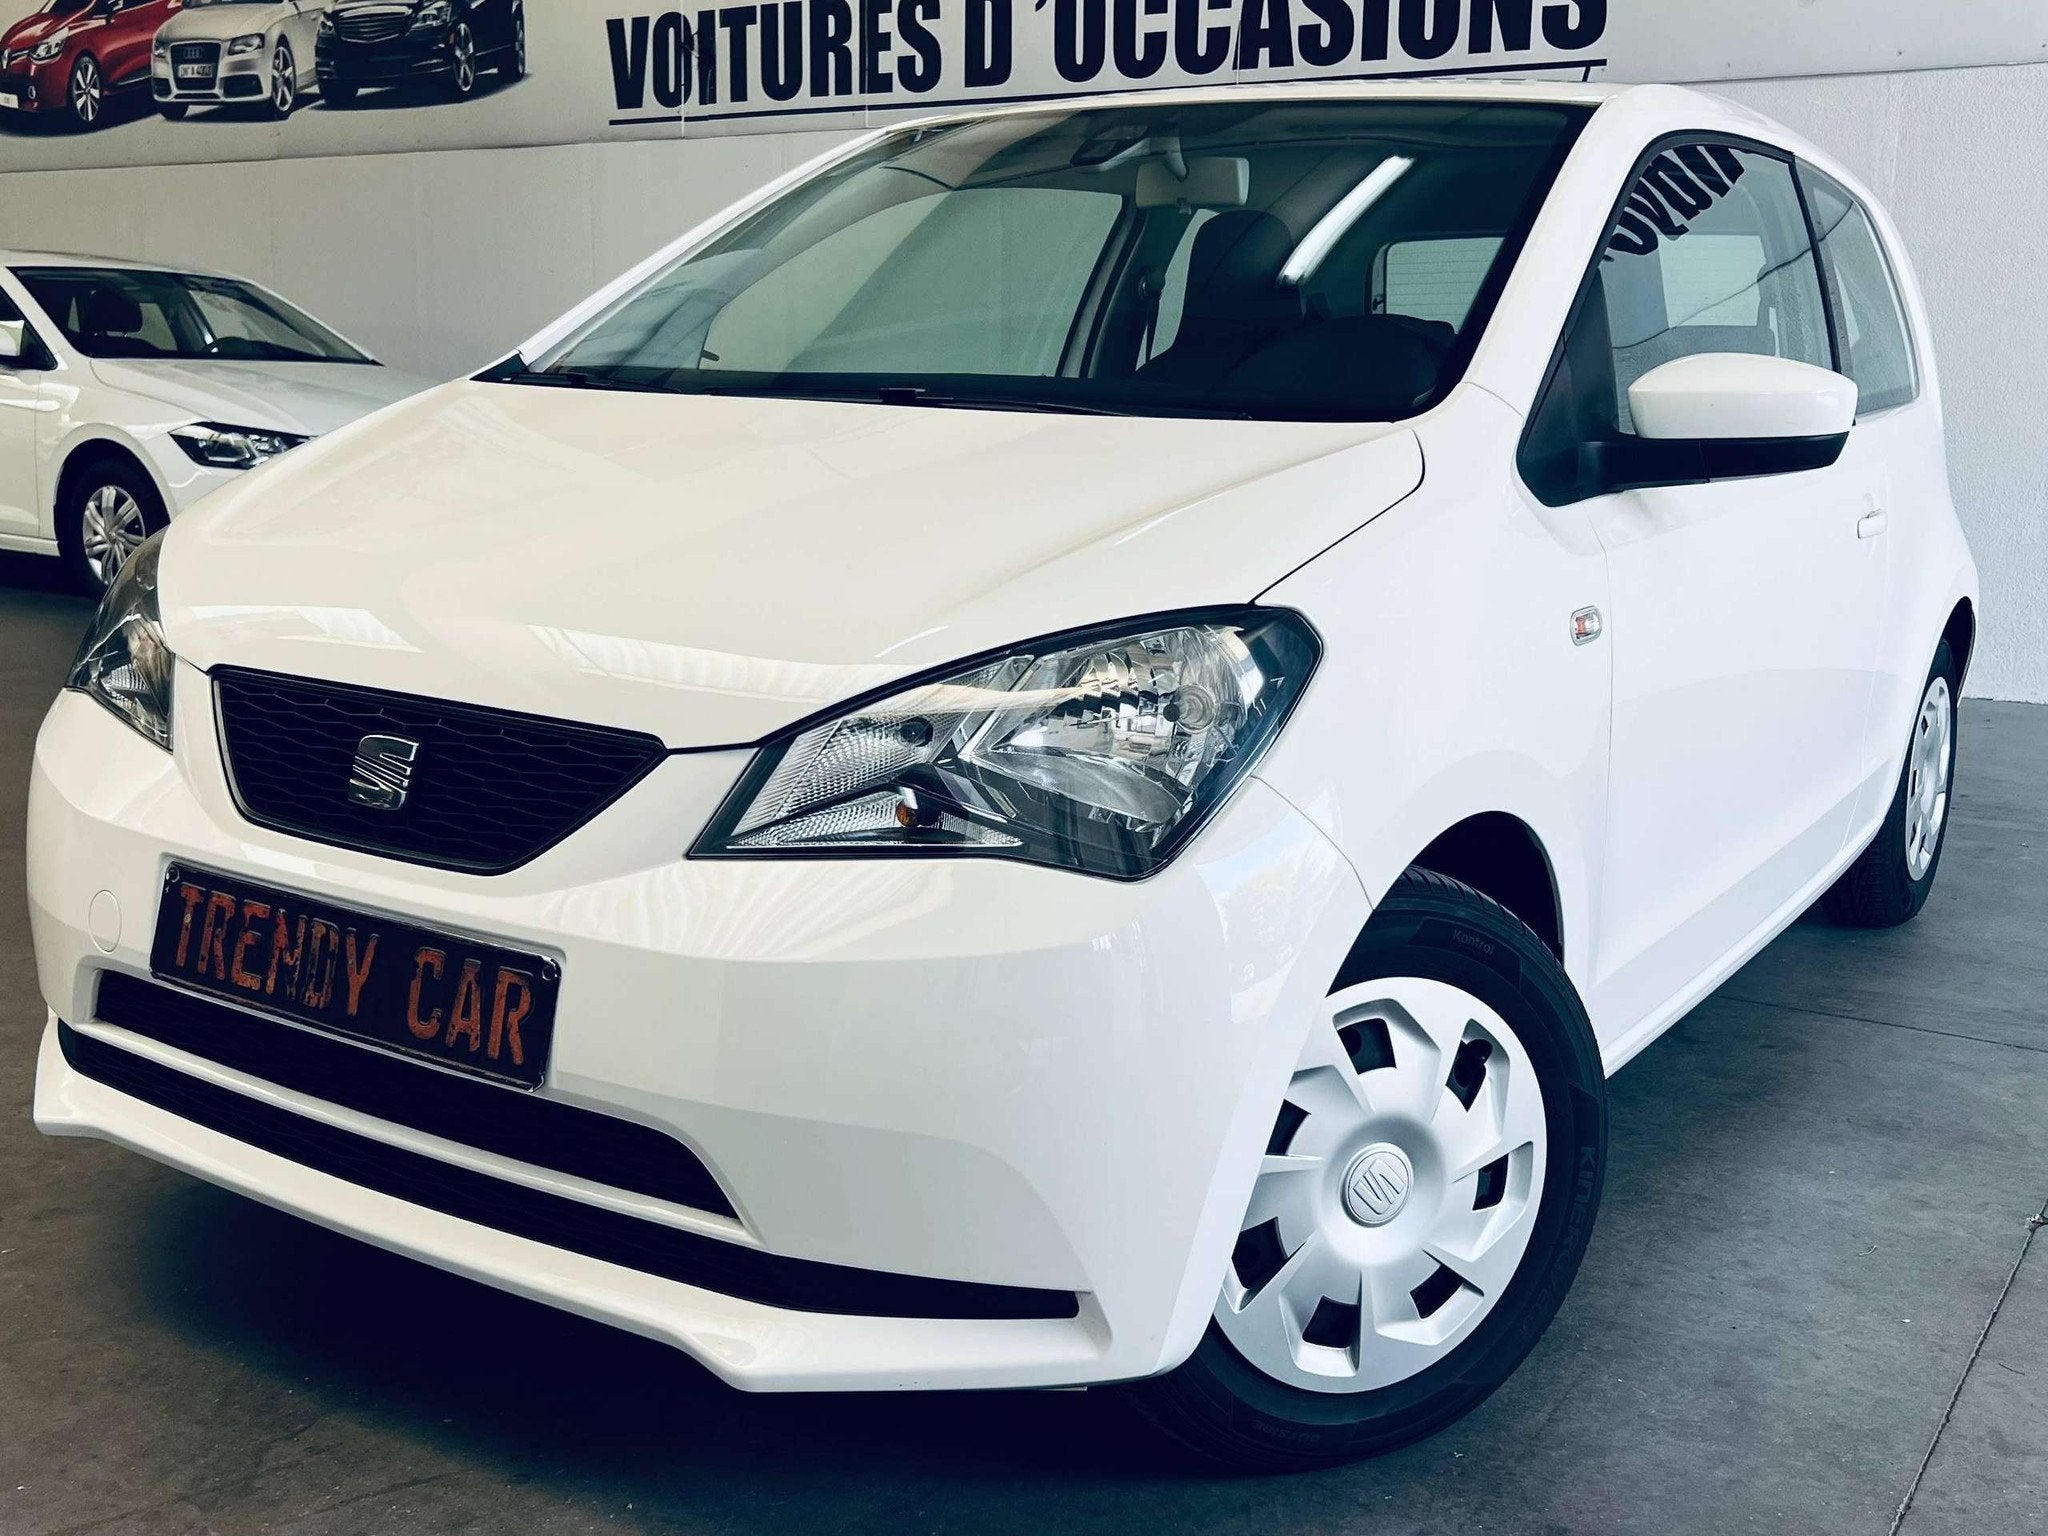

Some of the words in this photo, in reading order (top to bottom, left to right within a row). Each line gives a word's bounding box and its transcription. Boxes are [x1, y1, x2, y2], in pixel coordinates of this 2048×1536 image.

[605, 0, 942, 110] VOITURES
[175, 881, 379, 1017] TRENDY
[406, 946, 535, 1067] CAR
[1452, 928, 1495, 956] Kontrol
